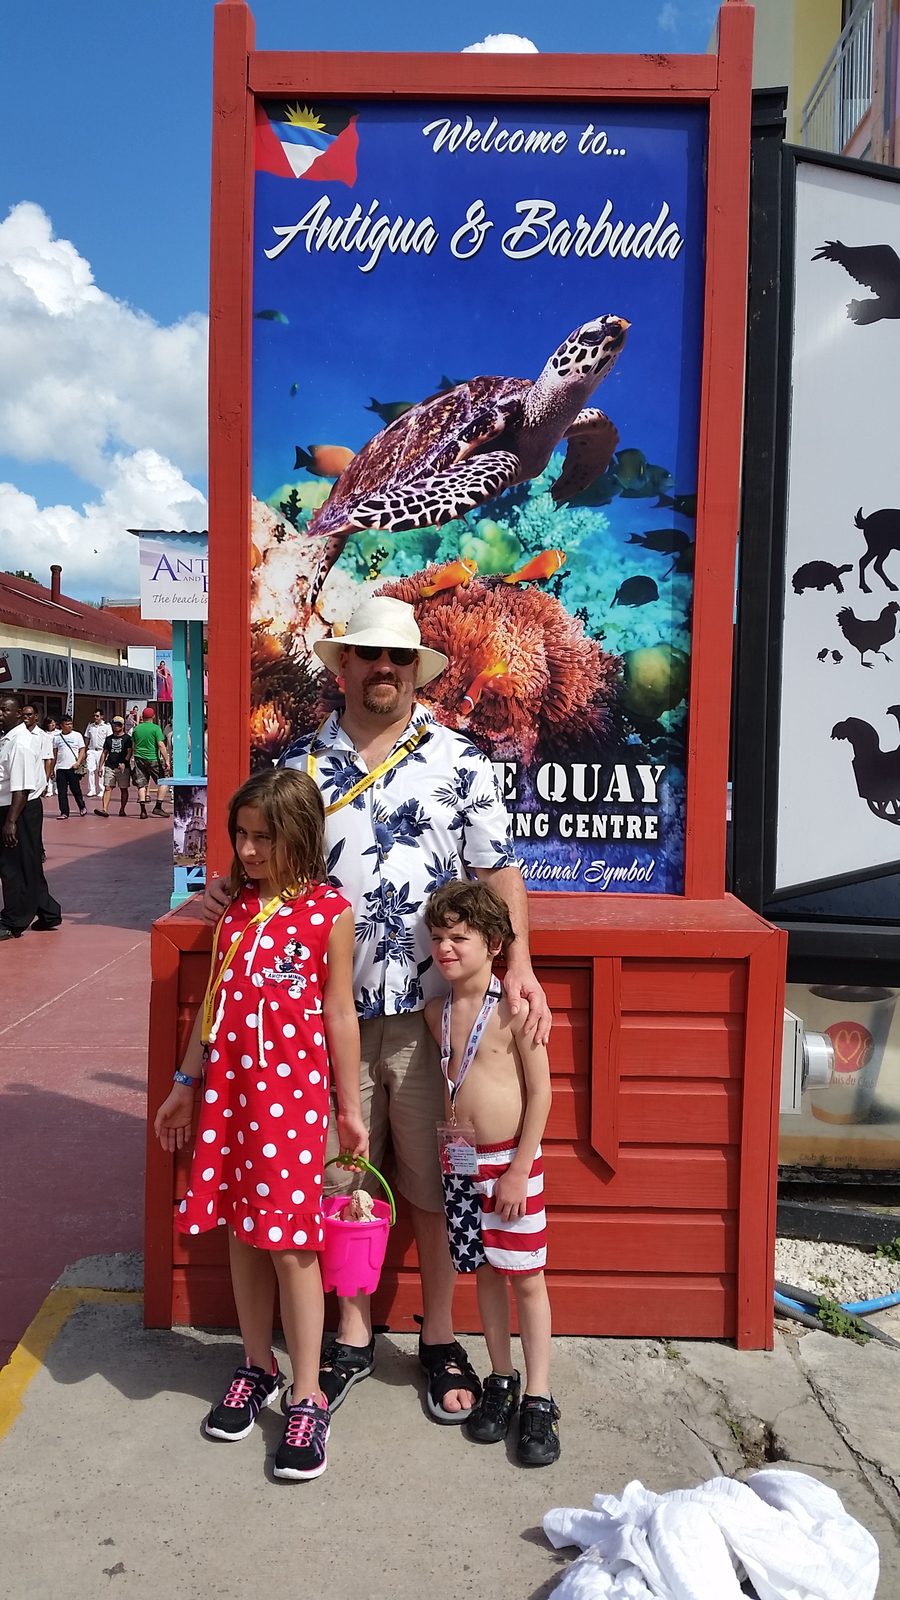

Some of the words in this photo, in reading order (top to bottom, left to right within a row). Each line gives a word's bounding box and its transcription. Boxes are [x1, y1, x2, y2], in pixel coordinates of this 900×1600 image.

[422, 114, 569, 154] Welcome
[577, 122, 627, 156] to...
[450, 199, 494, 260] &
[500, 198, 686, 260] Barbuda
[153, 593, 171, 604] The
[172, 593, 199, 604] beach
[89, 665, 154, 697] INTERNATIONAL
[536, 762, 667, 804] QUAY
[559, 813, 659, 840] CENTRE
[583, 859, 655, 890] Symbol
